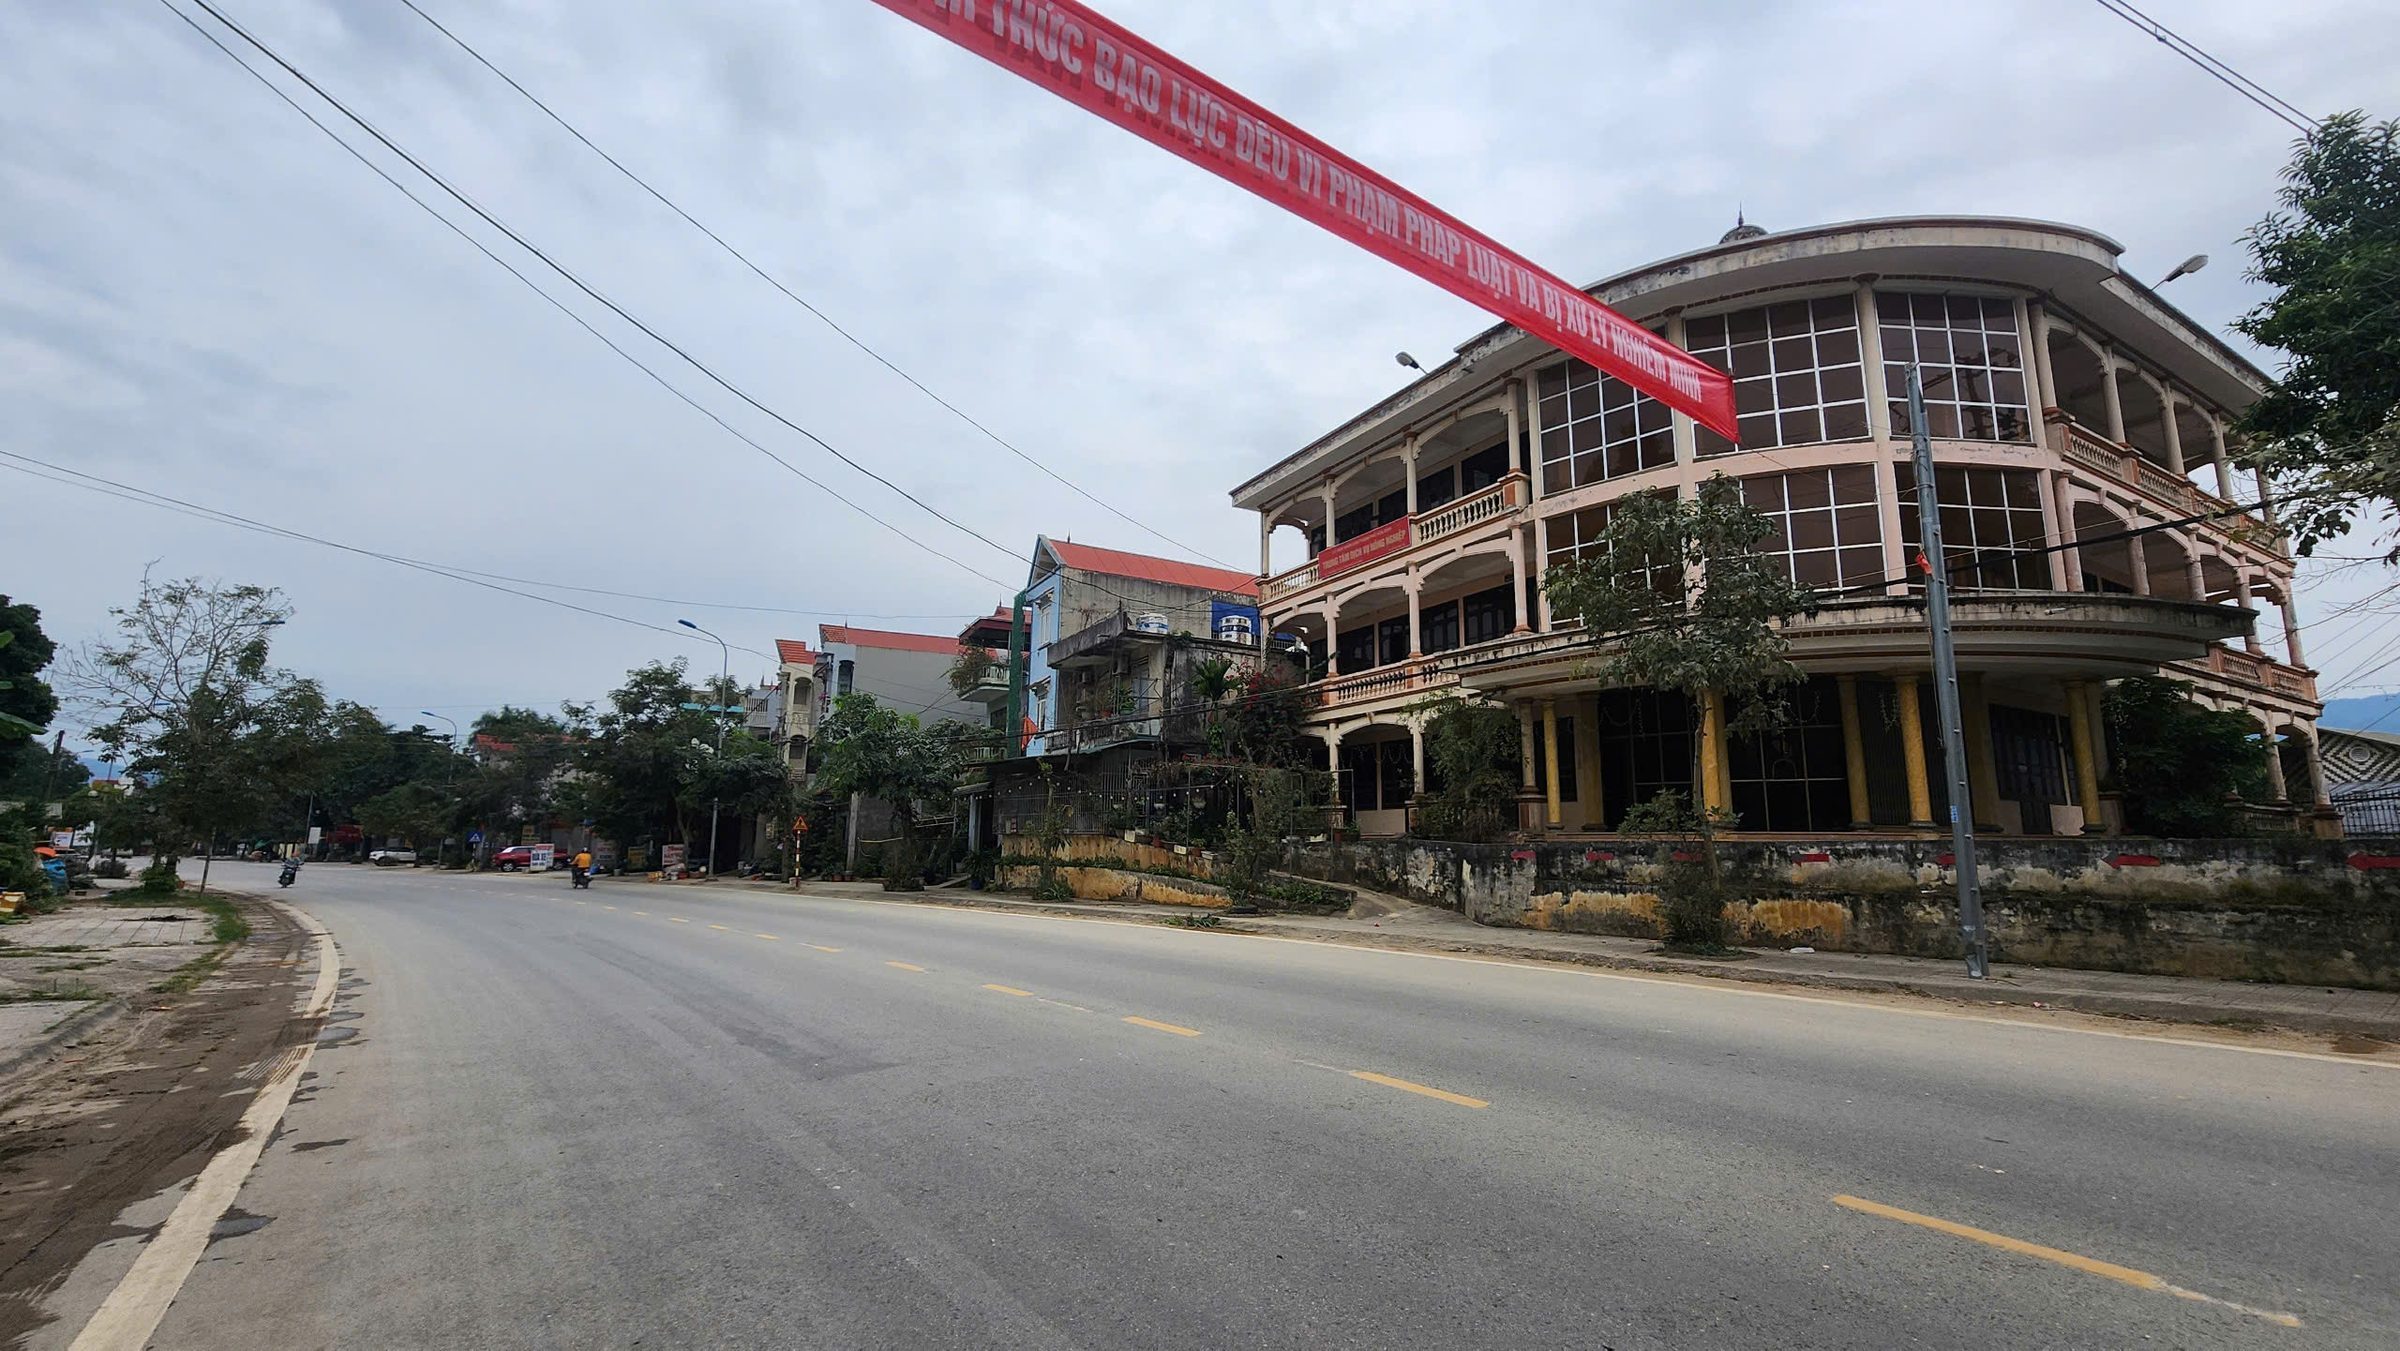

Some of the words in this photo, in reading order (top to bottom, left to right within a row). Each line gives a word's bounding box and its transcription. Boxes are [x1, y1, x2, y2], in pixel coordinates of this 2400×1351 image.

[1095, 38, 1161, 113] BẠO
[1170, 79, 1228, 147] LỰC
[1296, 146, 1322, 199] VI
[1328, 165, 1399, 238] PHẠM
[1405, 203, 1460, 268] PHÁP
[1542, 283, 1563, 333] BỊ
[1588, 312, 1609, 349] LÝ
[1610, 322, 1667, 383] NGHIÊM
[1667, 356, 1702, 403] MINH
